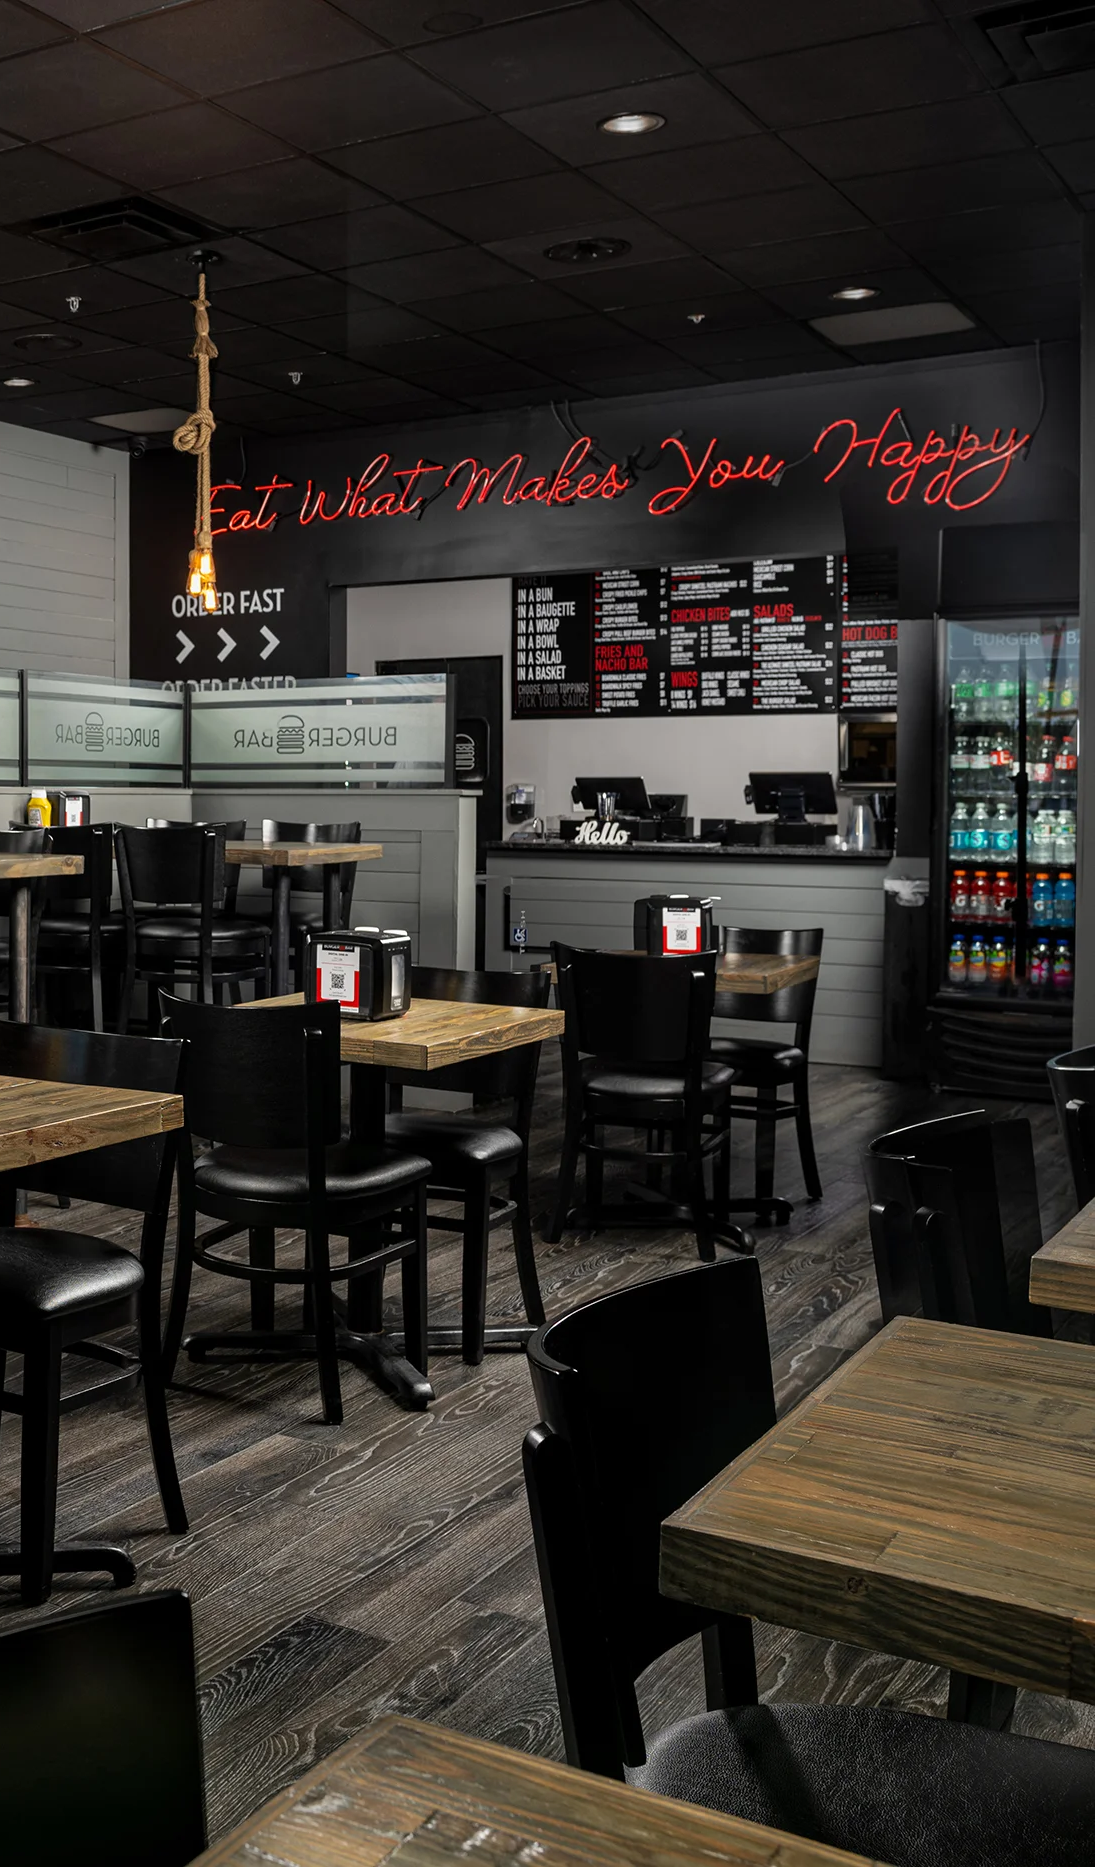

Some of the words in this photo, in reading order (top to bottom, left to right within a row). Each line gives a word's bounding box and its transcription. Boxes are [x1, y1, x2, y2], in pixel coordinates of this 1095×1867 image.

[195, 475, 294, 535] Eat
[299, 453, 443, 525] What
[445, 436, 628, 511] Makes
[648, 438, 785, 516] You
[813, 408, 1030, 511] Happy
[240, 588, 285, 614] FAST
[517, 589, 526, 603] IN
[528, 588, 534, 602] A
[536, 587, 553, 602] BUN
[517, 604, 526, 618] IN
[528, 604, 534, 618] A
[671, 608, 706, 623] CHICKEN
[707, 607, 731, 621] BITES
[753, 603, 794, 618] SALADS
[517, 620, 526, 634] IN
[528, 619, 534, 633] A
[535, 618, 559, 633] WRAP
[842, 627, 863, 641] HOT
[865, 626, 887, 640] DOG
[517, 636, 526, 649] IN
[528, 635, 534, 649] A
[535, 634, 559, 648] BOWL
[973, 632, 1040, 646] BURGER
[517, 651, 526, 665] IN
[528, 651, 534, 665] A
[535, 650, 561, 664] SALAD
[595, 645, 621, 658] FRIES
[624, 644, 643, 657] AND
[595, 658, 627, 671] NACHO
[629, 657, 648, 670] BAR
[517, 667, 526, 681] IN
[528, 666, 534, 680] A
[535, 665, 566, 680] BASKET
[671, 671, 698, 688] WINGS
[517, 684, 541, 694] CHOOSE
[542, 683, 558, 694] YOUR
[559, 682, 589, 694] TOPPINGS
[518, 696, 536, 708] PICK
[539, 695, 559, 707] YOUR
[562, 694, 589, 706] SAUCE
[575, 820, 631, 845] Hello
